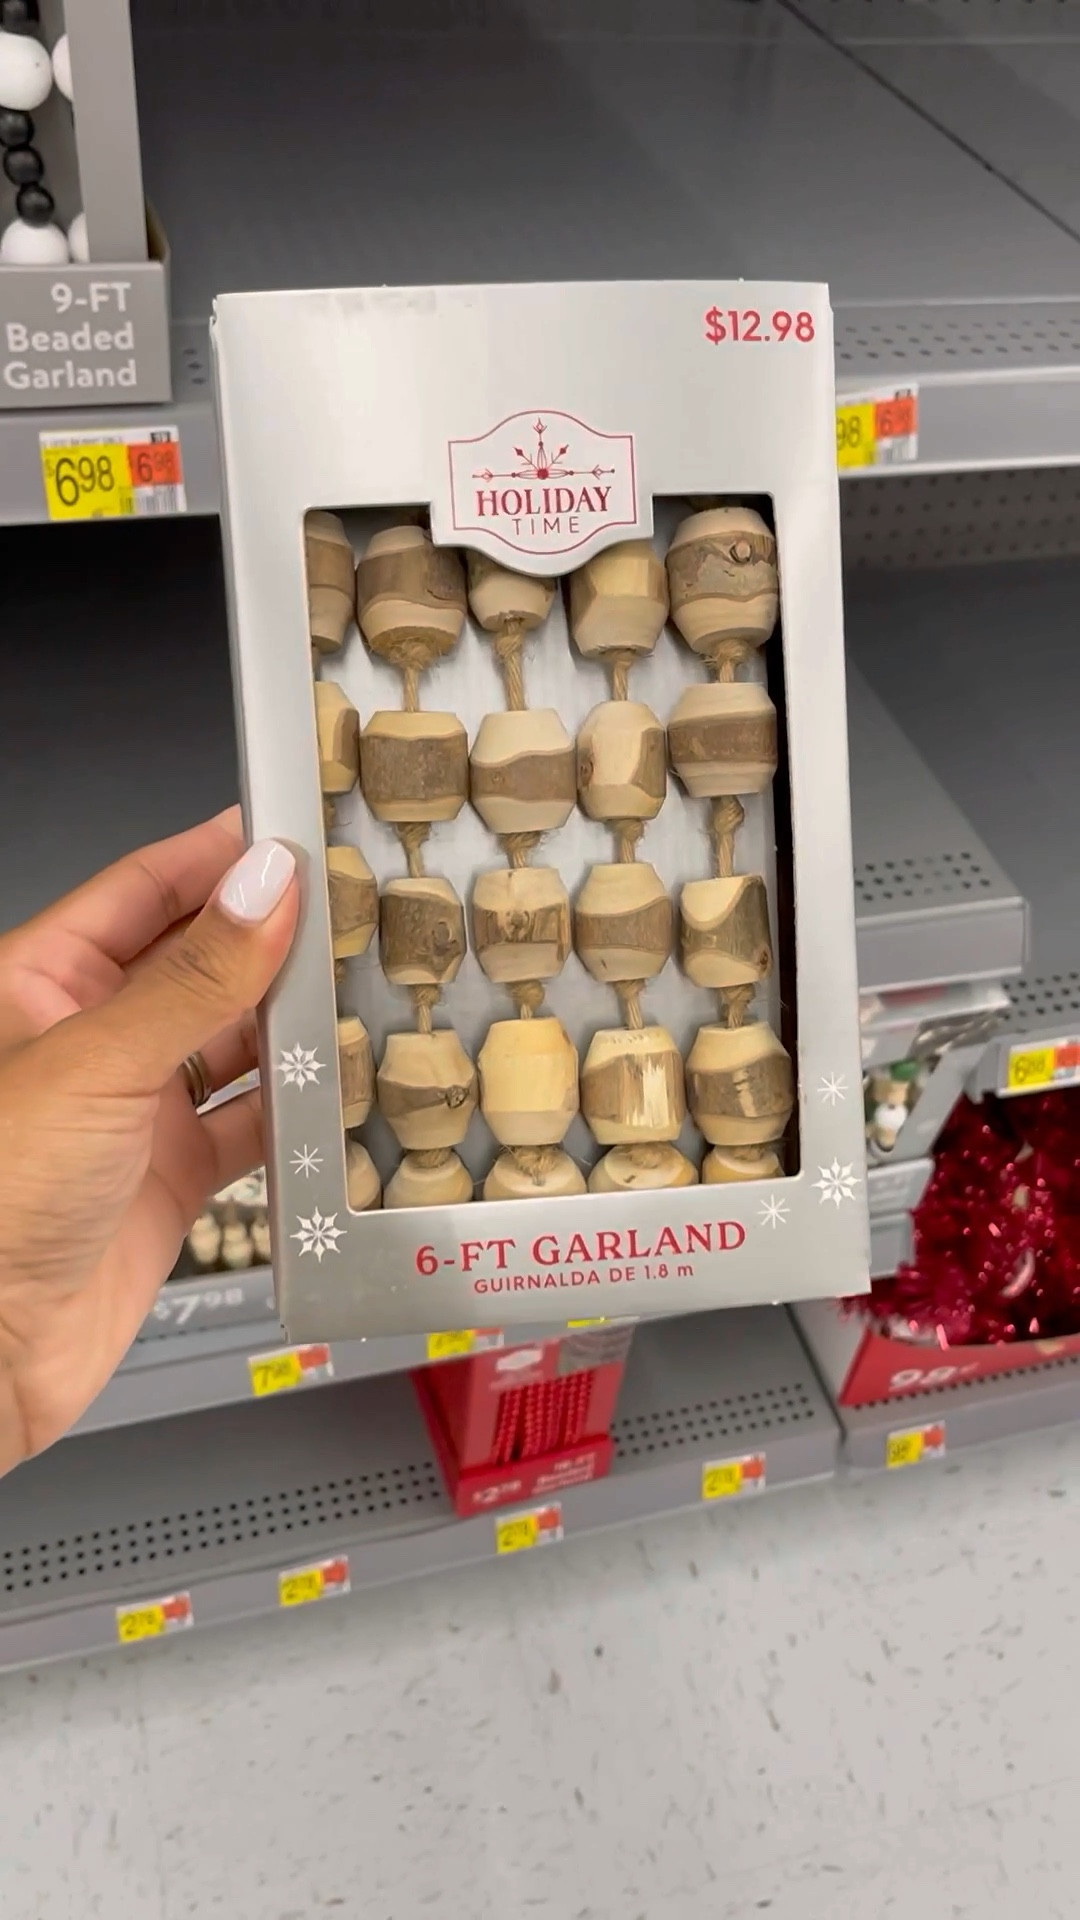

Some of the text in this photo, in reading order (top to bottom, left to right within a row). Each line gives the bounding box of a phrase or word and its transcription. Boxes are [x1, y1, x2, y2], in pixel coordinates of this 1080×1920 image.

[51, 282, 131, 313] 9-FT
[6, 321, 135, 353] Beaded
[705, 306, 815, 345] $12.98
[3, 359, 137, 389] Garland
[476, 486, 612, 517] HOLIDAY
[512, 516, 580, 536] TIME
[416, 1221, 746, 1275] 6-FT GARLAND
[474, 1263, 694, 1294] GUIRNALDA DE 1.8 m
